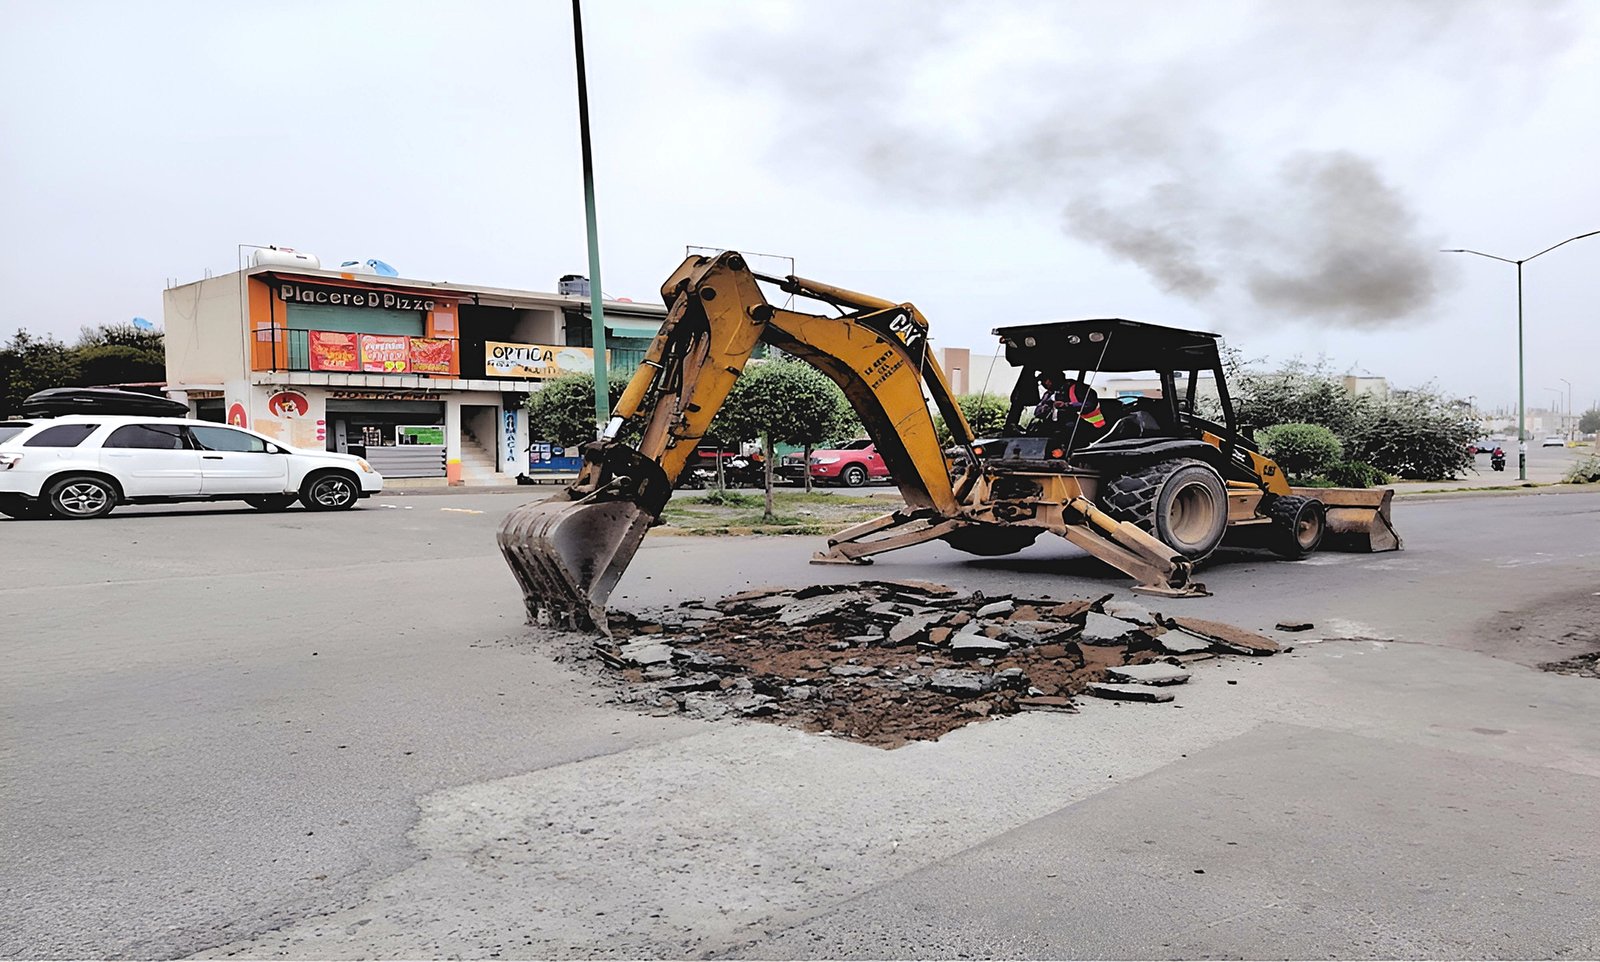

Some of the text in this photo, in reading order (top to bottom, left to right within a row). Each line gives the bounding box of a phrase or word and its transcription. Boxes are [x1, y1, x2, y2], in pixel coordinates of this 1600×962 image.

[368, 292, 380, 307] D
[889, 313, 921, 347] CAT
[492, 345, 554, 362] OPTICA
